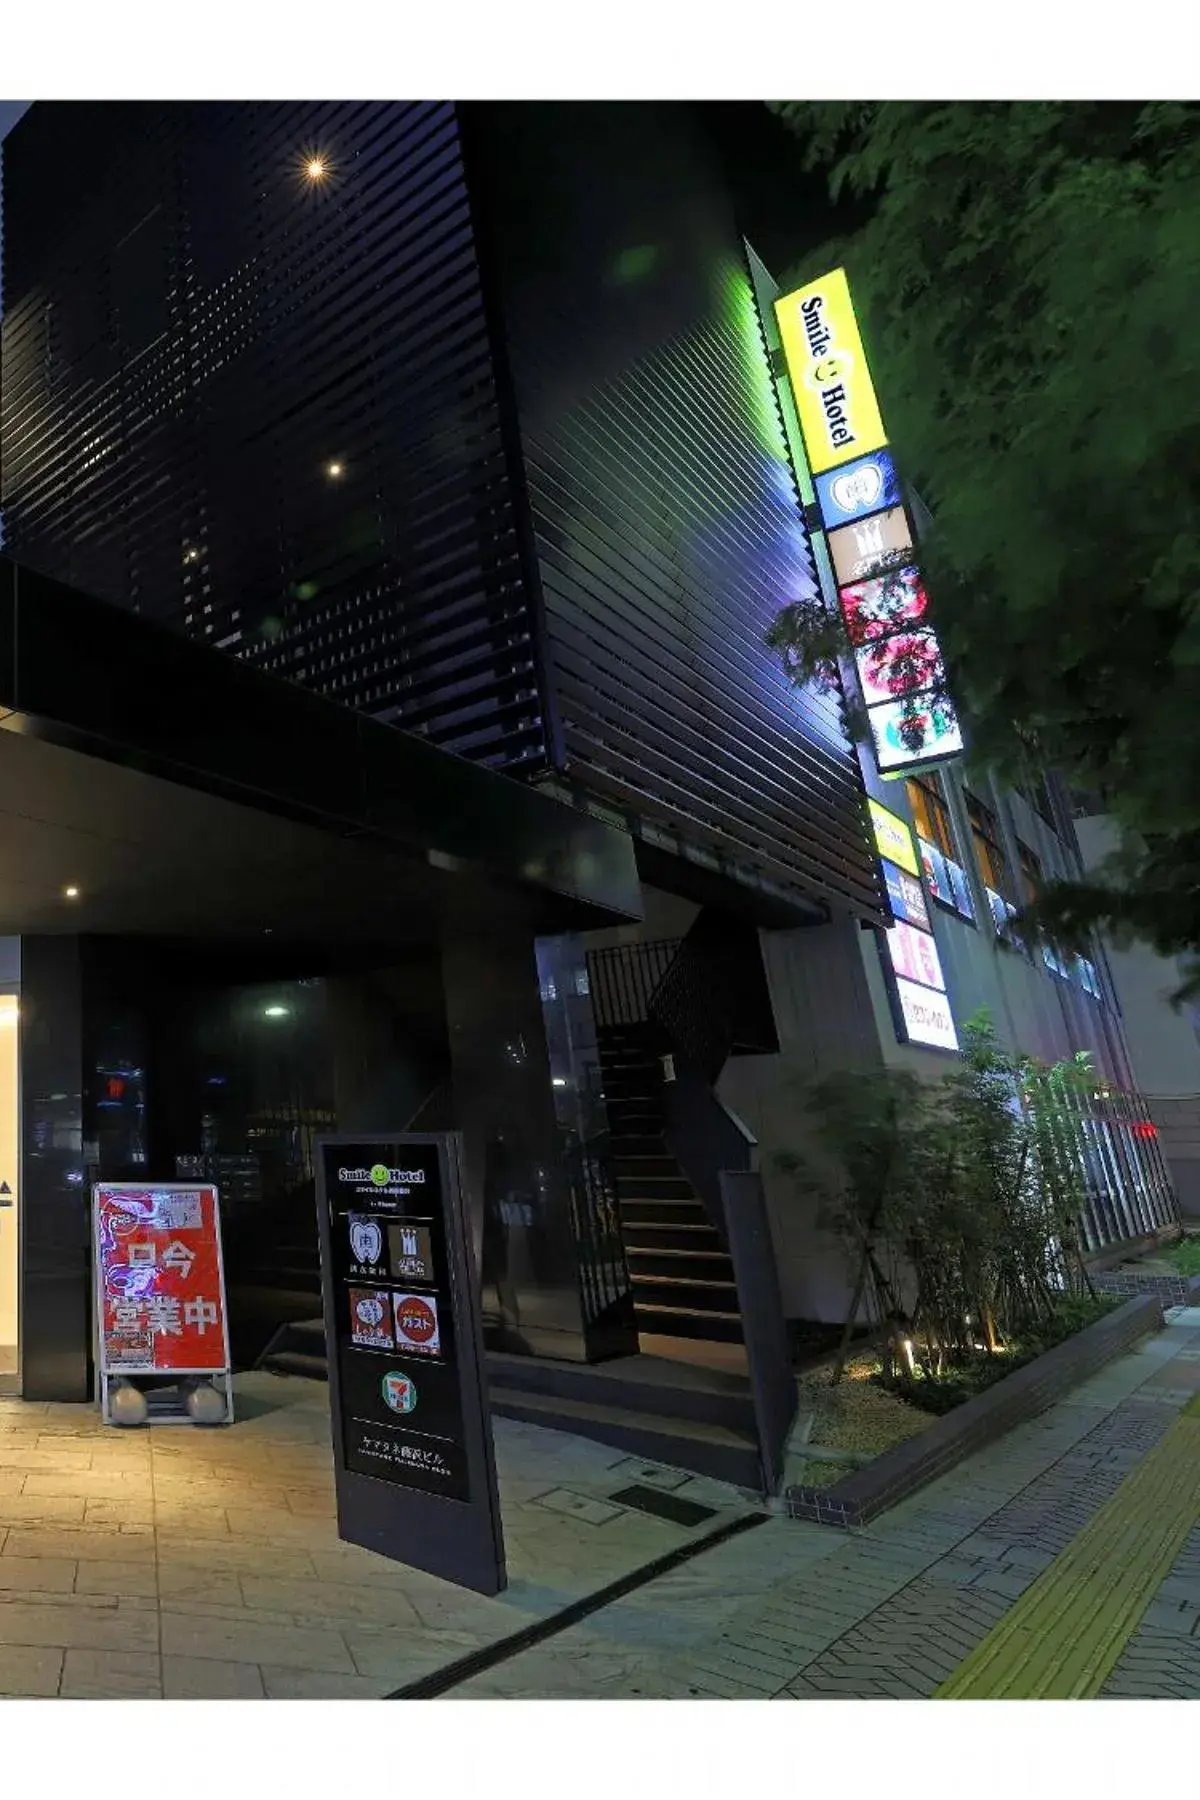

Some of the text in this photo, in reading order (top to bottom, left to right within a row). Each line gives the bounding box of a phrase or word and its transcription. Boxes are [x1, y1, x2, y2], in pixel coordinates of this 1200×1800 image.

[801, 296, 855, 449] Smile Hotel
[339, 1168, 425, 1183] Smile Hotel
[111, 1295, 217, 1337] 営業中
